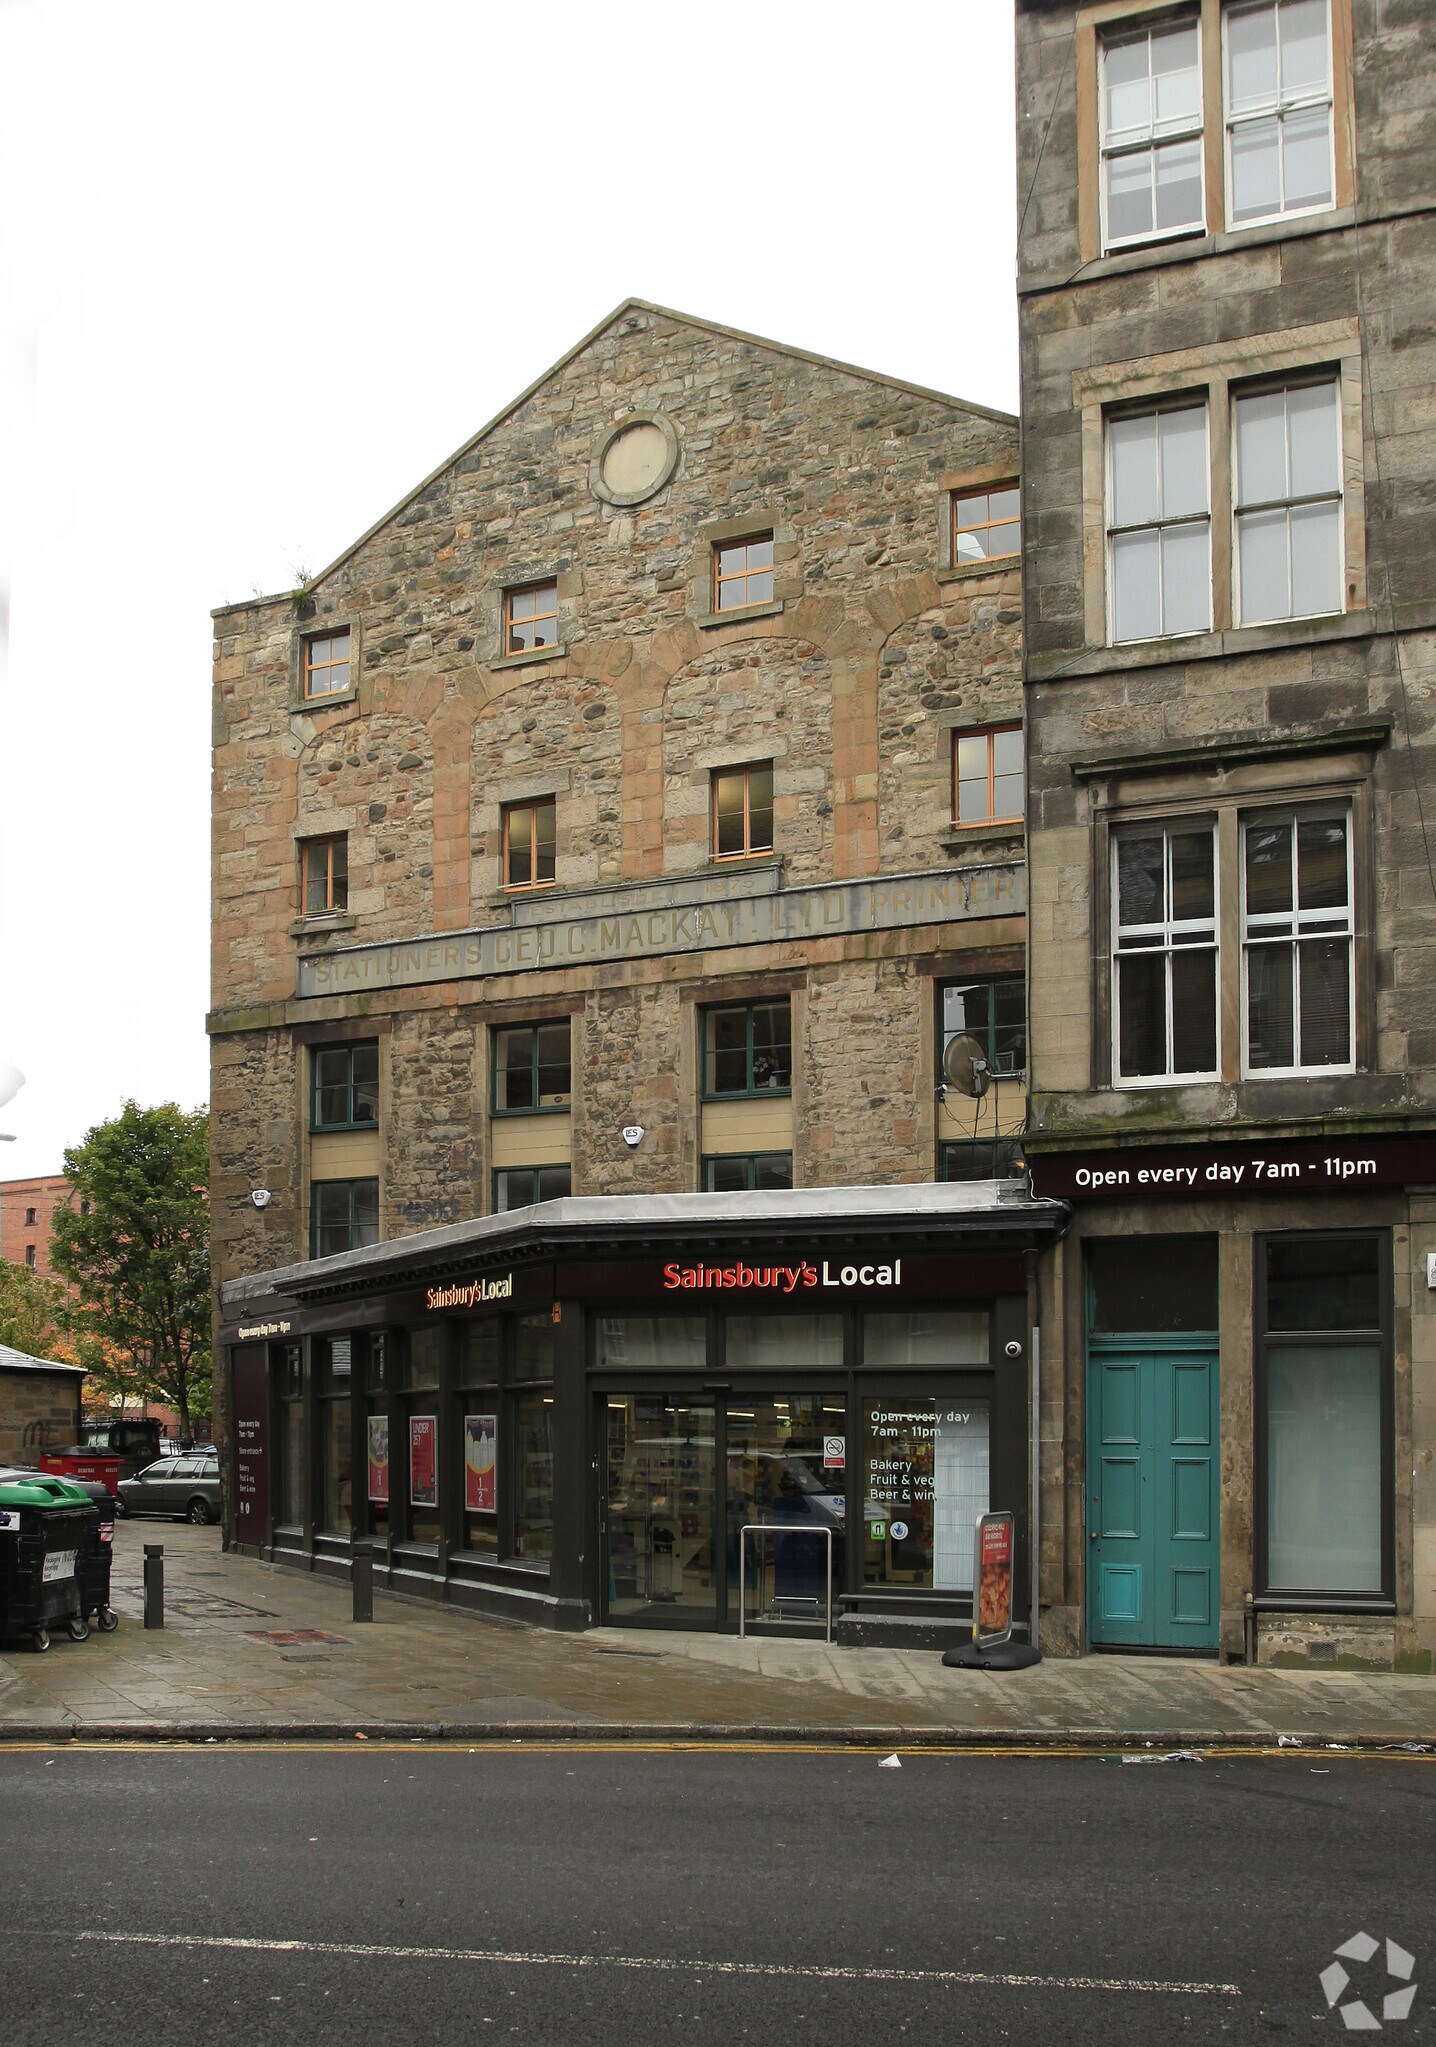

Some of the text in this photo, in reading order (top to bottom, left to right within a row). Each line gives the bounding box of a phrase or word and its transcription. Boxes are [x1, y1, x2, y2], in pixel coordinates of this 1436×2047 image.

[315, 943, 482, 984] STATIONERS
[1075, 1168, 1130, 1188] Open
[1137, 1167, 1198, 1185] every
[1205, 1162, 1245, 1183] day
[1251, 1160, 1300, 1179] 7am
[1323, 1157, 1377, 1179] 11pm
[663, 1258, 901, 1293] Sainsbury's Local
[426, 1272, 512, 1310] Sainsbury's Local
[871, 1411, 970, 1424] Open every day
[412, 1422, 429, 1434] UNDER
[871, 1426, 898, 1437] 7am
[911, 1425, 941, 1438] 11pm
[870, 1459, 912, 1472] Bakery
[870, 1474, 935, 1487] Fruit & veg
[870, 1489, 899, 1500] Beer
[901, 1489, 911, 1500] &
